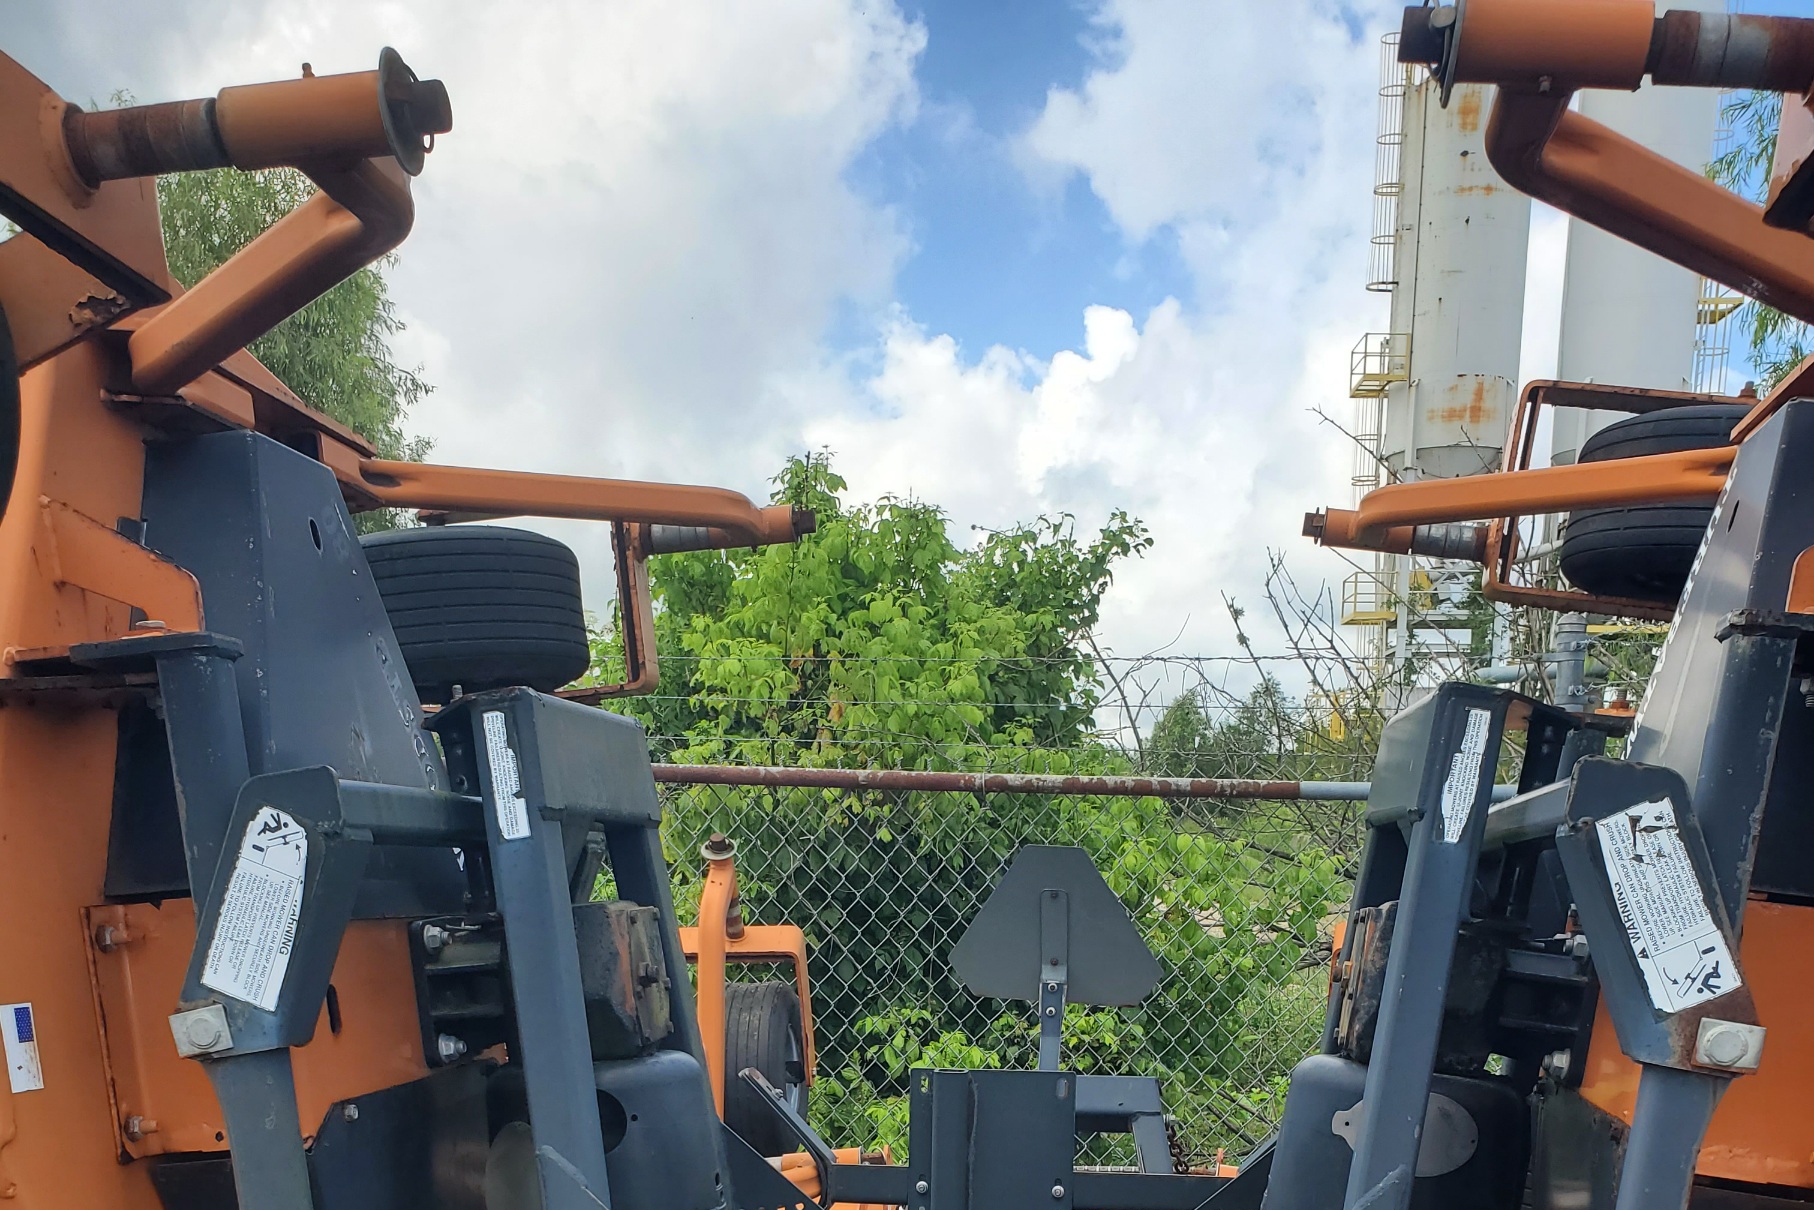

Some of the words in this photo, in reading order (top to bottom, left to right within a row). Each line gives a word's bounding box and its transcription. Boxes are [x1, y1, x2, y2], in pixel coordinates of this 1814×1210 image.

[1621, 465, 1737, 761] TURFBATW
[1447, 755, 1458, 794] IMPORTANT
[1603, 822, 1618, 846] CRUSH
[1620, 822, 1631, 840] BLOCK
[1653, 833, 1659, 841] OR
[1613, 846, 1624, 861] AND
[1645, 847, 1657, 868] MOWER
[1620, 862, 1632, 882] DROP
[1658, 865, 1668, 882] LATCH
[1663, 859, 1672, 873] LEAK
[1679, 864, 1692, 888] FOLLOW
[1627, 881, 1639, 898] CAN
[1669, 873, 1684, 904] HYDRAULIC
[1675, 874, 1687, 895] SYSTEM
[1688, 888, 1695, 896] TO
[1664, 896, 1671, 904] UP
[1665, 882, 1681, 913] TRANSPORT
[274, 904, 286, 929] MOWER
[1612, 881, 1641, 943] WARNING
[1634, 898, 1650, 926] MOWER
[1678, 914, 1687, 930] FROM
[269, 930, 278, 944] CAN
[278, 899, 298, 956] ARNING
[1645, 925, 1660, 952] RAISED
[263, 944, 274, 964] DROP
[259, 963, 268, 978] AND
[252, 979, 263, 1001] CRUSH
